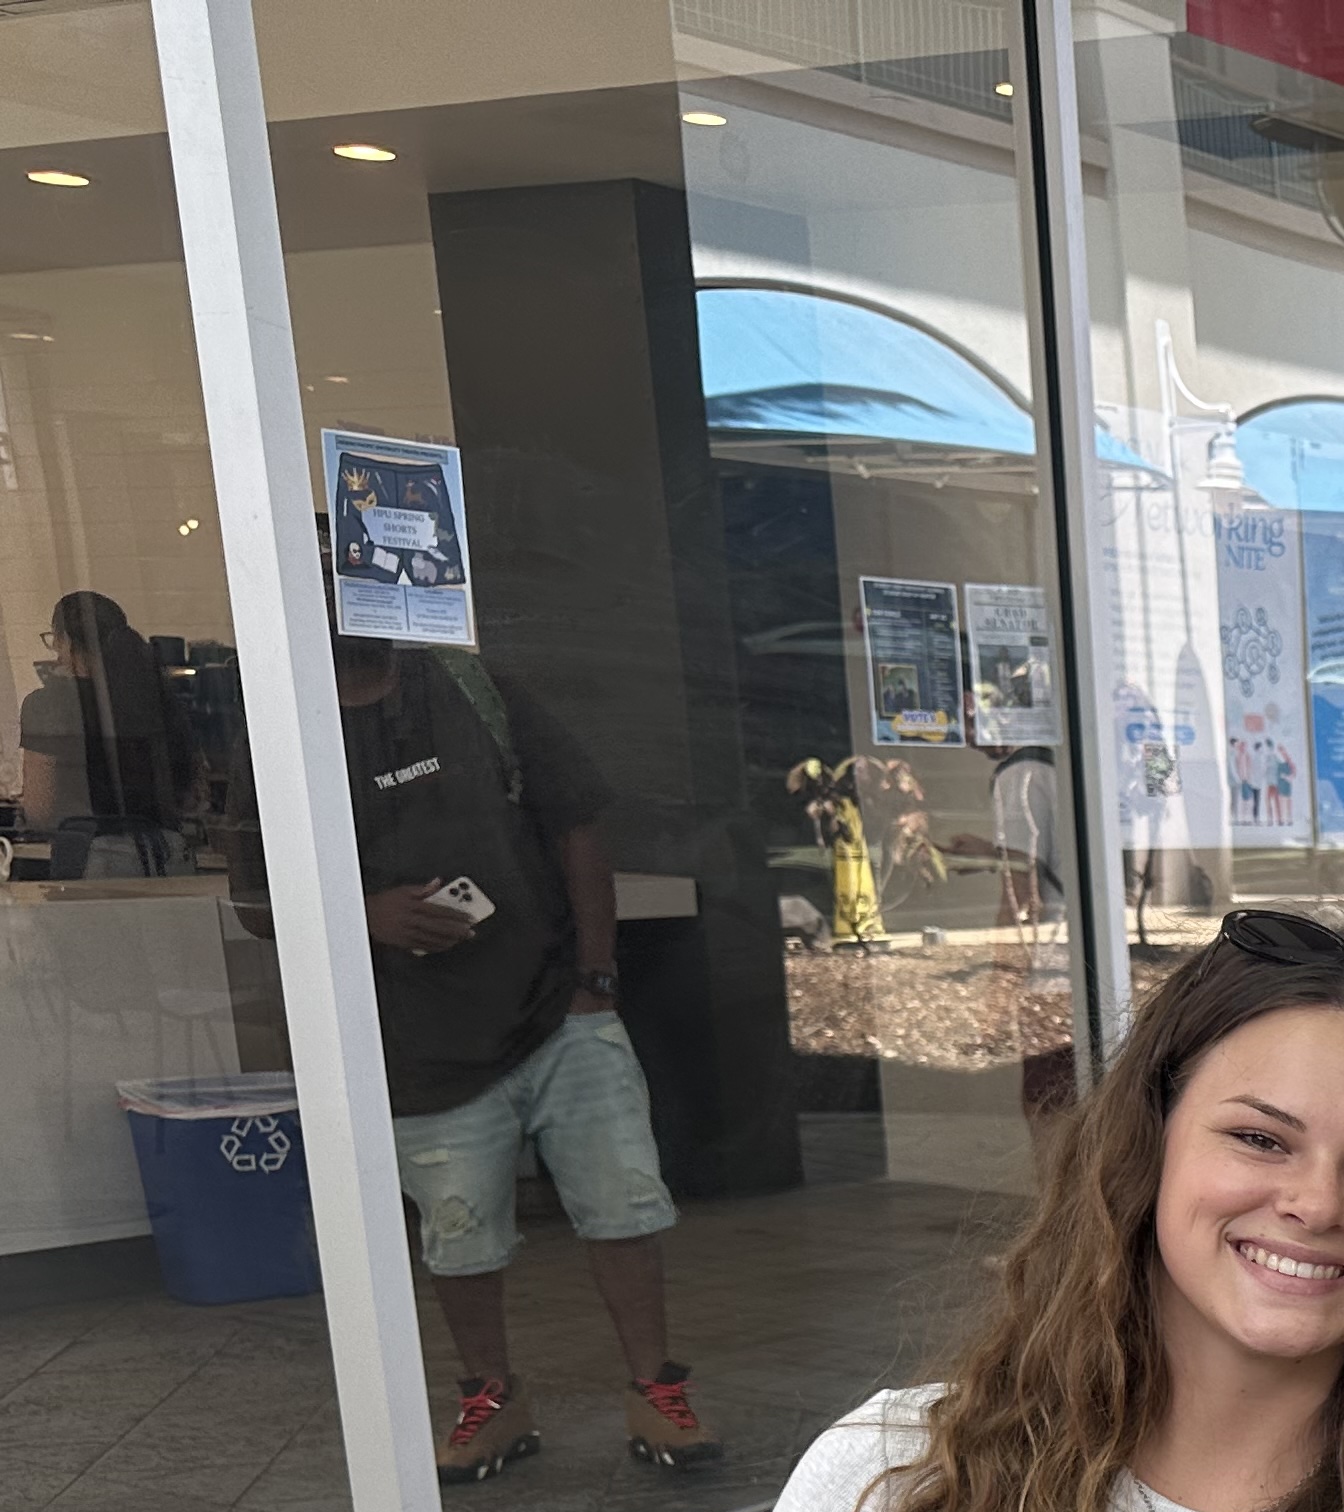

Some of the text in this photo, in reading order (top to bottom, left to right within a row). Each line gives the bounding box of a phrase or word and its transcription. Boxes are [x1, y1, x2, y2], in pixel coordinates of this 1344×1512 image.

[393, 512, 424, 523] SPRING
[384, 524, 417, 535] SHORTS
[383, 535, 422, 547] FESTIVAL
[1224, 544, 1267, 572] NITE
[374, 757, 440, 790] THE GREATEST
